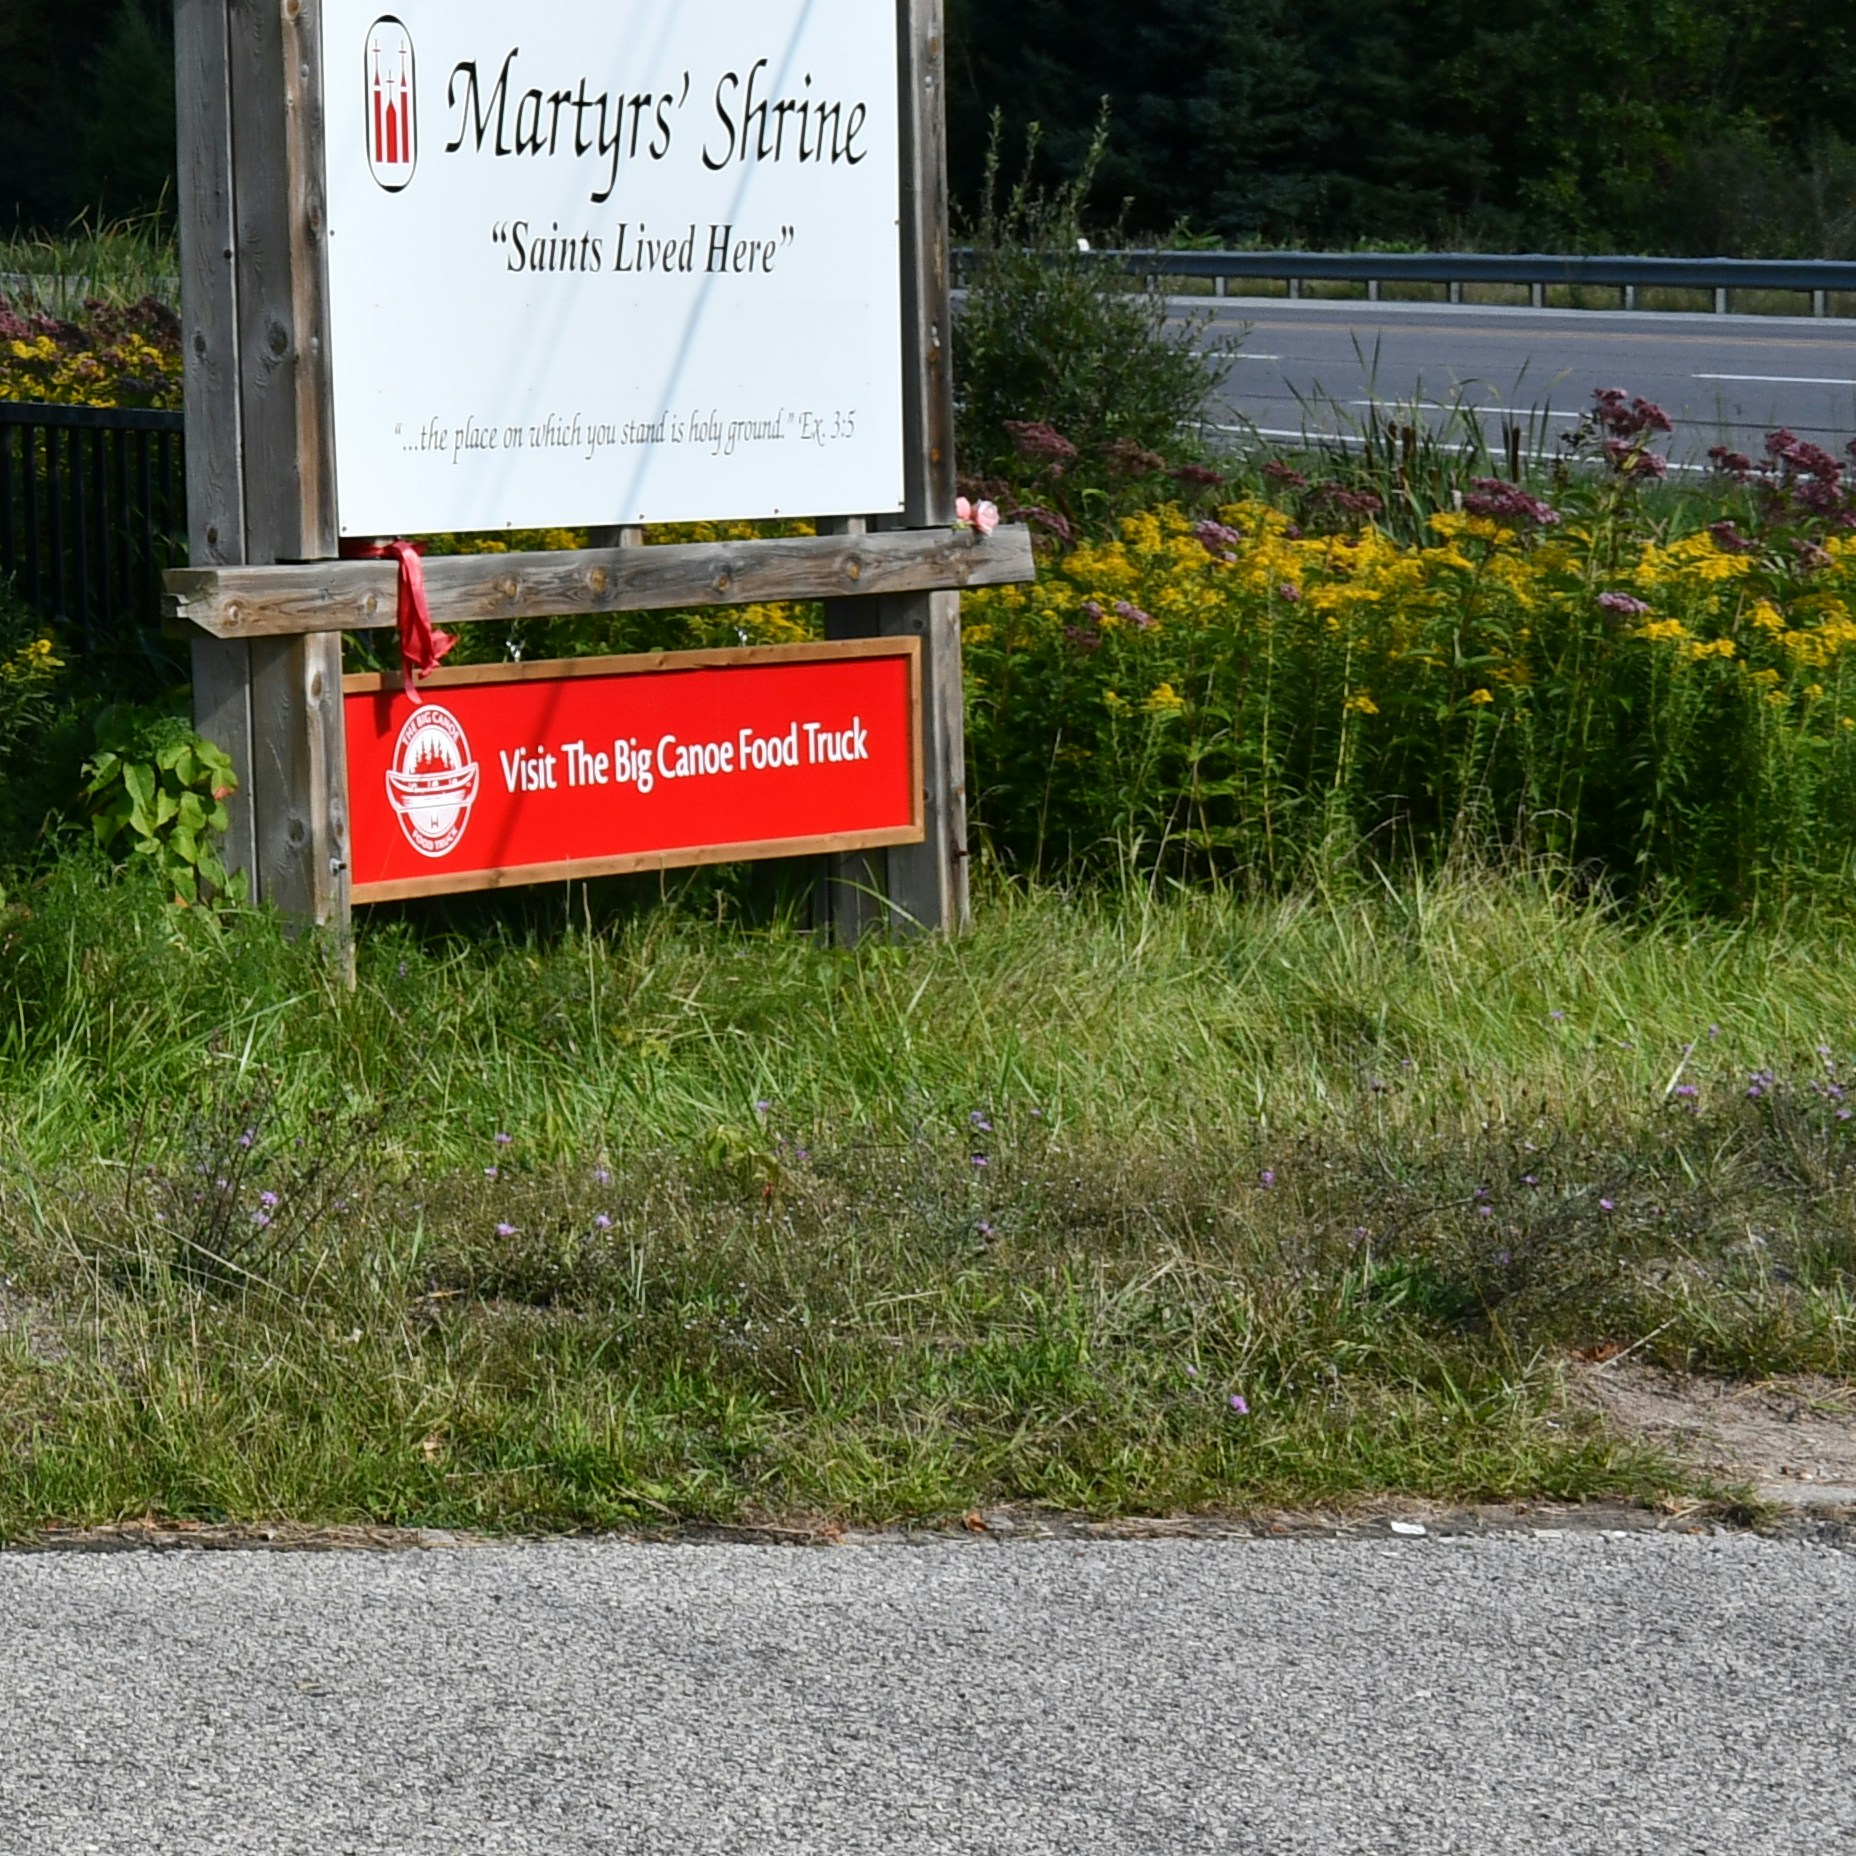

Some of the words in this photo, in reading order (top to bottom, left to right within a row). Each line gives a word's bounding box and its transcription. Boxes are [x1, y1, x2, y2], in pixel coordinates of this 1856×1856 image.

[444, 46, 691, 204] Martyrs'
[700, 58, 869, 171] Shrine
[492, 220, 603, 273] "Saints
[613, 222, 696, 273] Lived
[704, 223, 795, 273] Here"
[452, 414, 498, 465] place
[502, 424, 524, 449] on
[529, 412, 583, 448] which
[584, 423, 616, 461] you
[620, 410, 669, 445] stand
[671, 414, 685, 444] is
[688, 408, 722, 456] holy
[798, 410, 827, 447] Ex.
[830, 408, 856, 440] 3:5
[416, 711, 432, 728] BIG
[499, 745, 558, 793] Visit
[561, 739, 610, 787] The
[614, 737, 654, 794] Big
[656, 734, 734, 779] Canoe
[739, 720, 800, 771] Food
[802, 715, 870, 764] Truck
